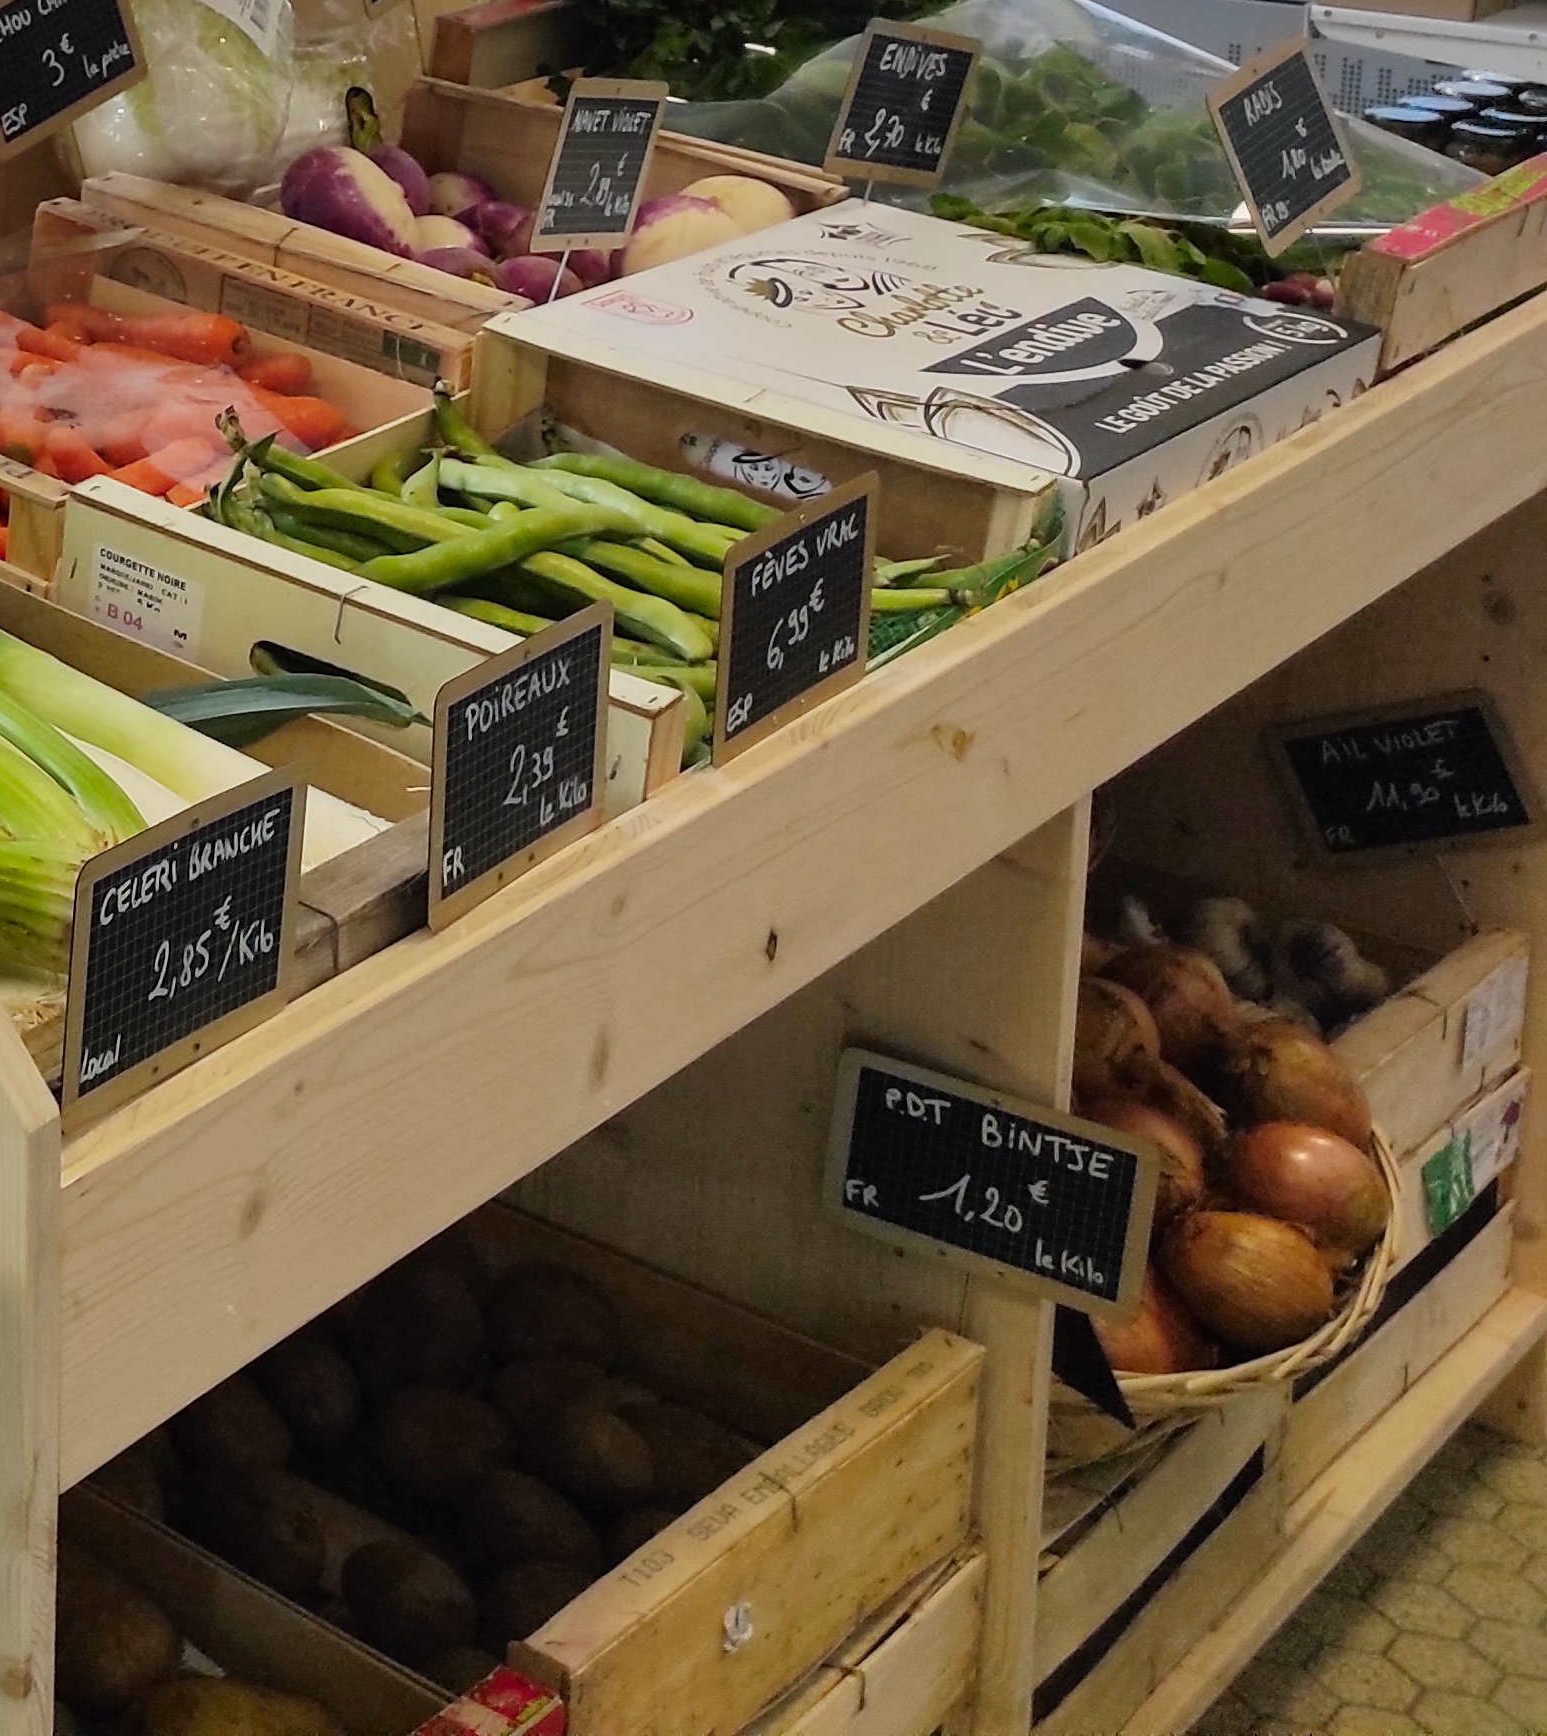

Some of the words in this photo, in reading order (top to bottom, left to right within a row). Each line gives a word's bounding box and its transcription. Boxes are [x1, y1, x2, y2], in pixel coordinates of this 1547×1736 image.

[42, 49, 65, 86] 3
[59, 33, 75, 54] €
[1, 103, 28, 135] ESP
[864, 108, 905, 157] 2,70
[836, 282, 985, 338] Charlotte
[960, 310, 1123, 376] L'endive
[1094, 409, 1129, 435] LE
[1120, 387, 1179, 427] GOÛT
[1170, 379, 1203, 402] DE
[1193, 370, 1224, 394] LA
[1213, 341, 1280, 383] PASSION
[100, 548, 155, 578] COURGETTE
[157, 571, 186, 591] NOIRE
[751, 539, 808, 597] FÈVES
[816, 513, 859, 557] VRAC
[107, 603, 118, 620] B
[123, 611, 143, 630] 04
[766, 604, 809, 671] 6,99
[808, 577, 825, 613] €
[726, 692, 753, 732] ESP
[503, 744, 554, 806] 2,39
[540, 793, 554, 827] le
[1326, 825, 1356, 846] FR
[189, 808, 281, 881] BRANCHE
[442, 845, 465, 887] FR
[148, 928, 212, 1002] 2,85
[845, 1179, 880, 1207] FR
[918, 1173, 1023, 1233] 1,20
[1028, 1180, 1050, 1204] €
[1035, 1238, 1054, 1270] le
